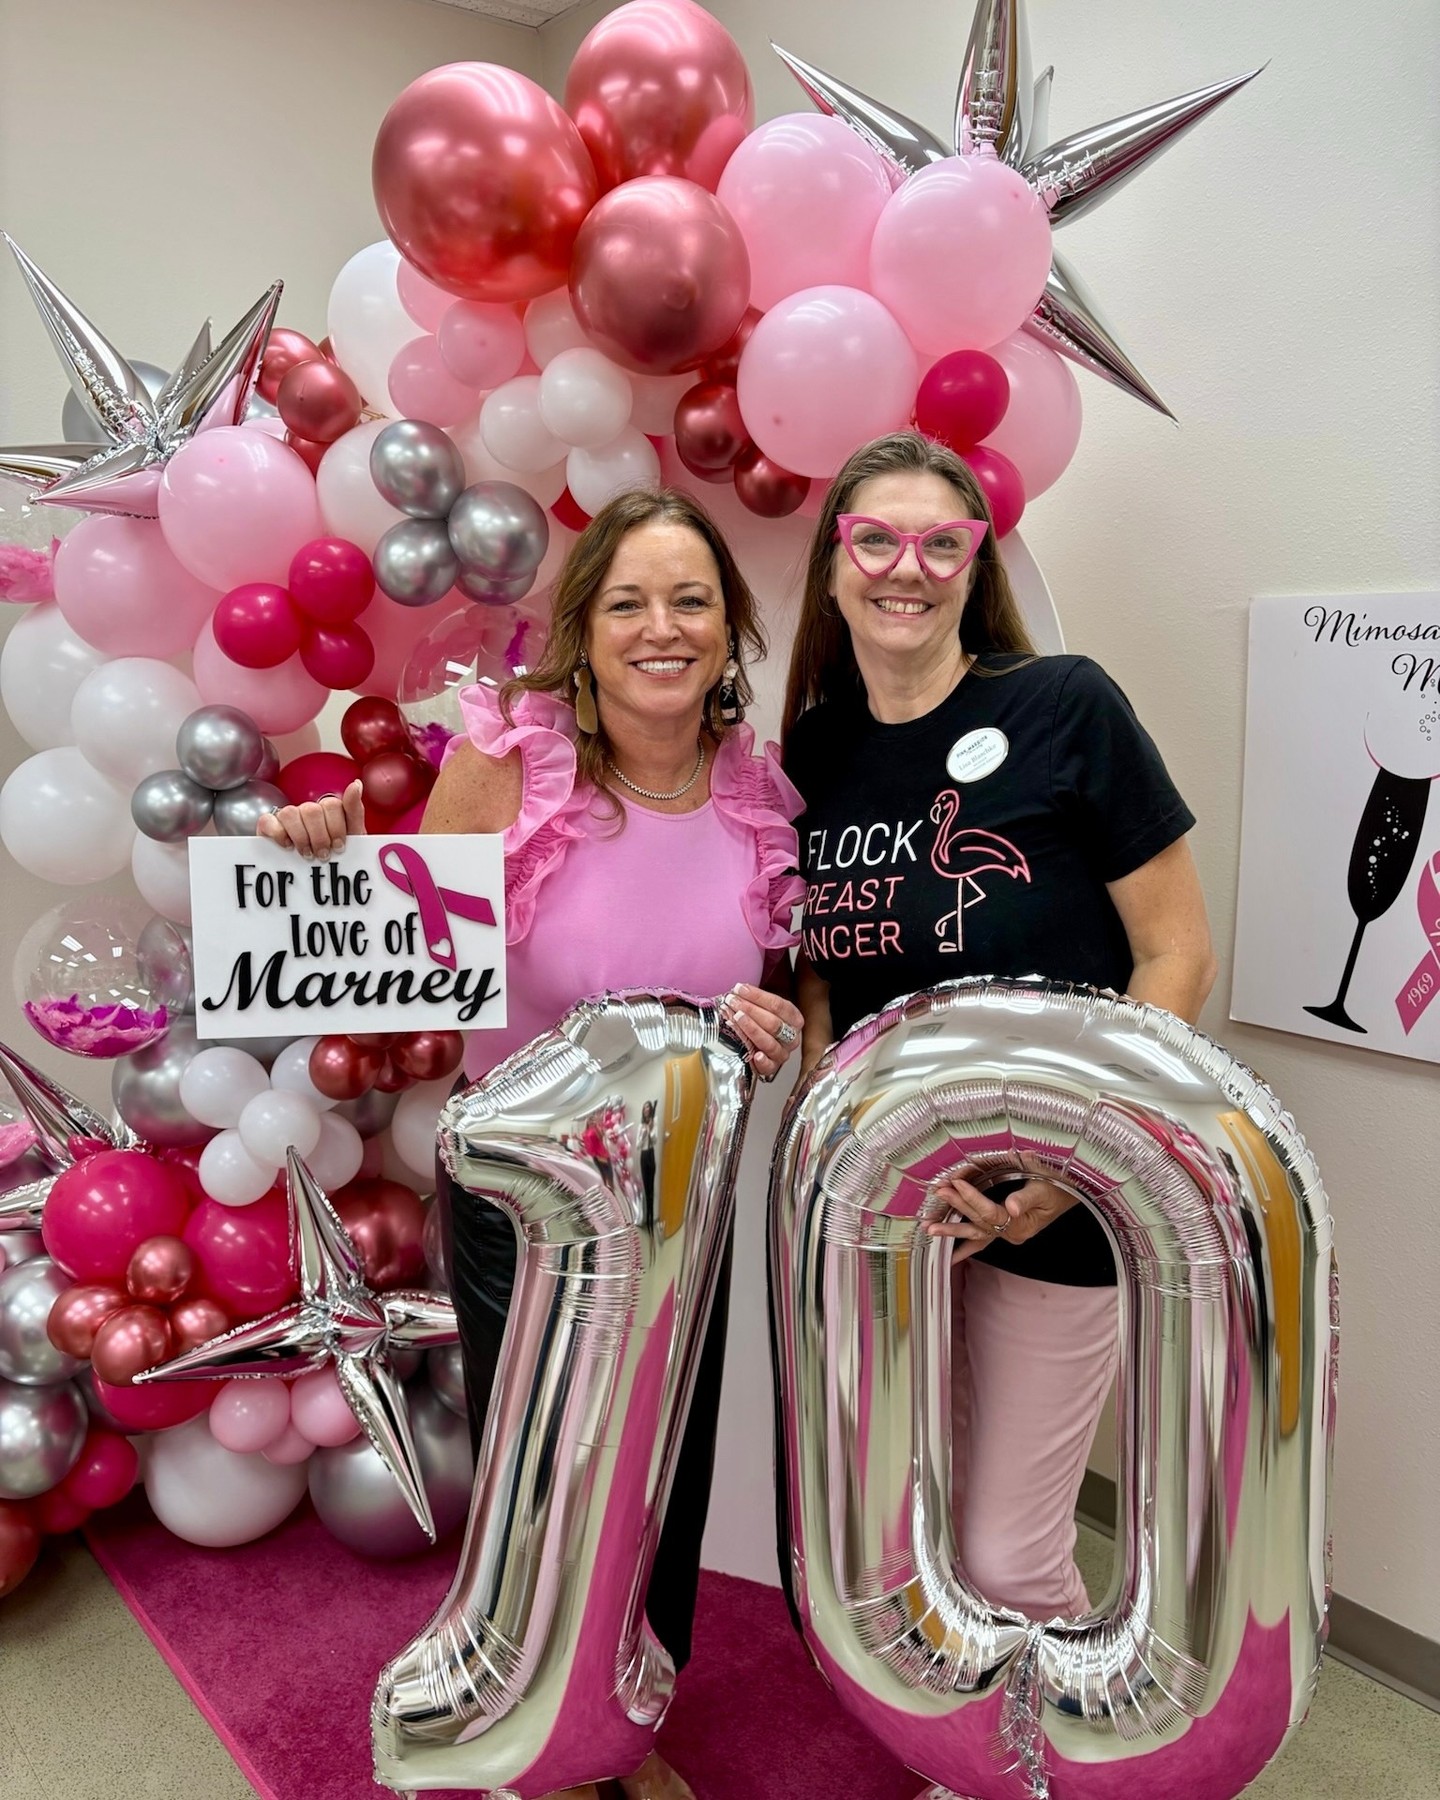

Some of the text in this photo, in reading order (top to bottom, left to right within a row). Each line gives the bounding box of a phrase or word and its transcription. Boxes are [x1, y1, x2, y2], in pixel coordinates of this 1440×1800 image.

[807, 819, 924, 871] FLOCK
[234, 862, 372, 908] For the
[803, 876, 905, 916] REAST
[290, 912, 418, 958] Love of
[802, 920, 904, 961] ANCER
[201, 950, 501, 1022] Marney
[1407, 972, 1434, 1008] 1969
